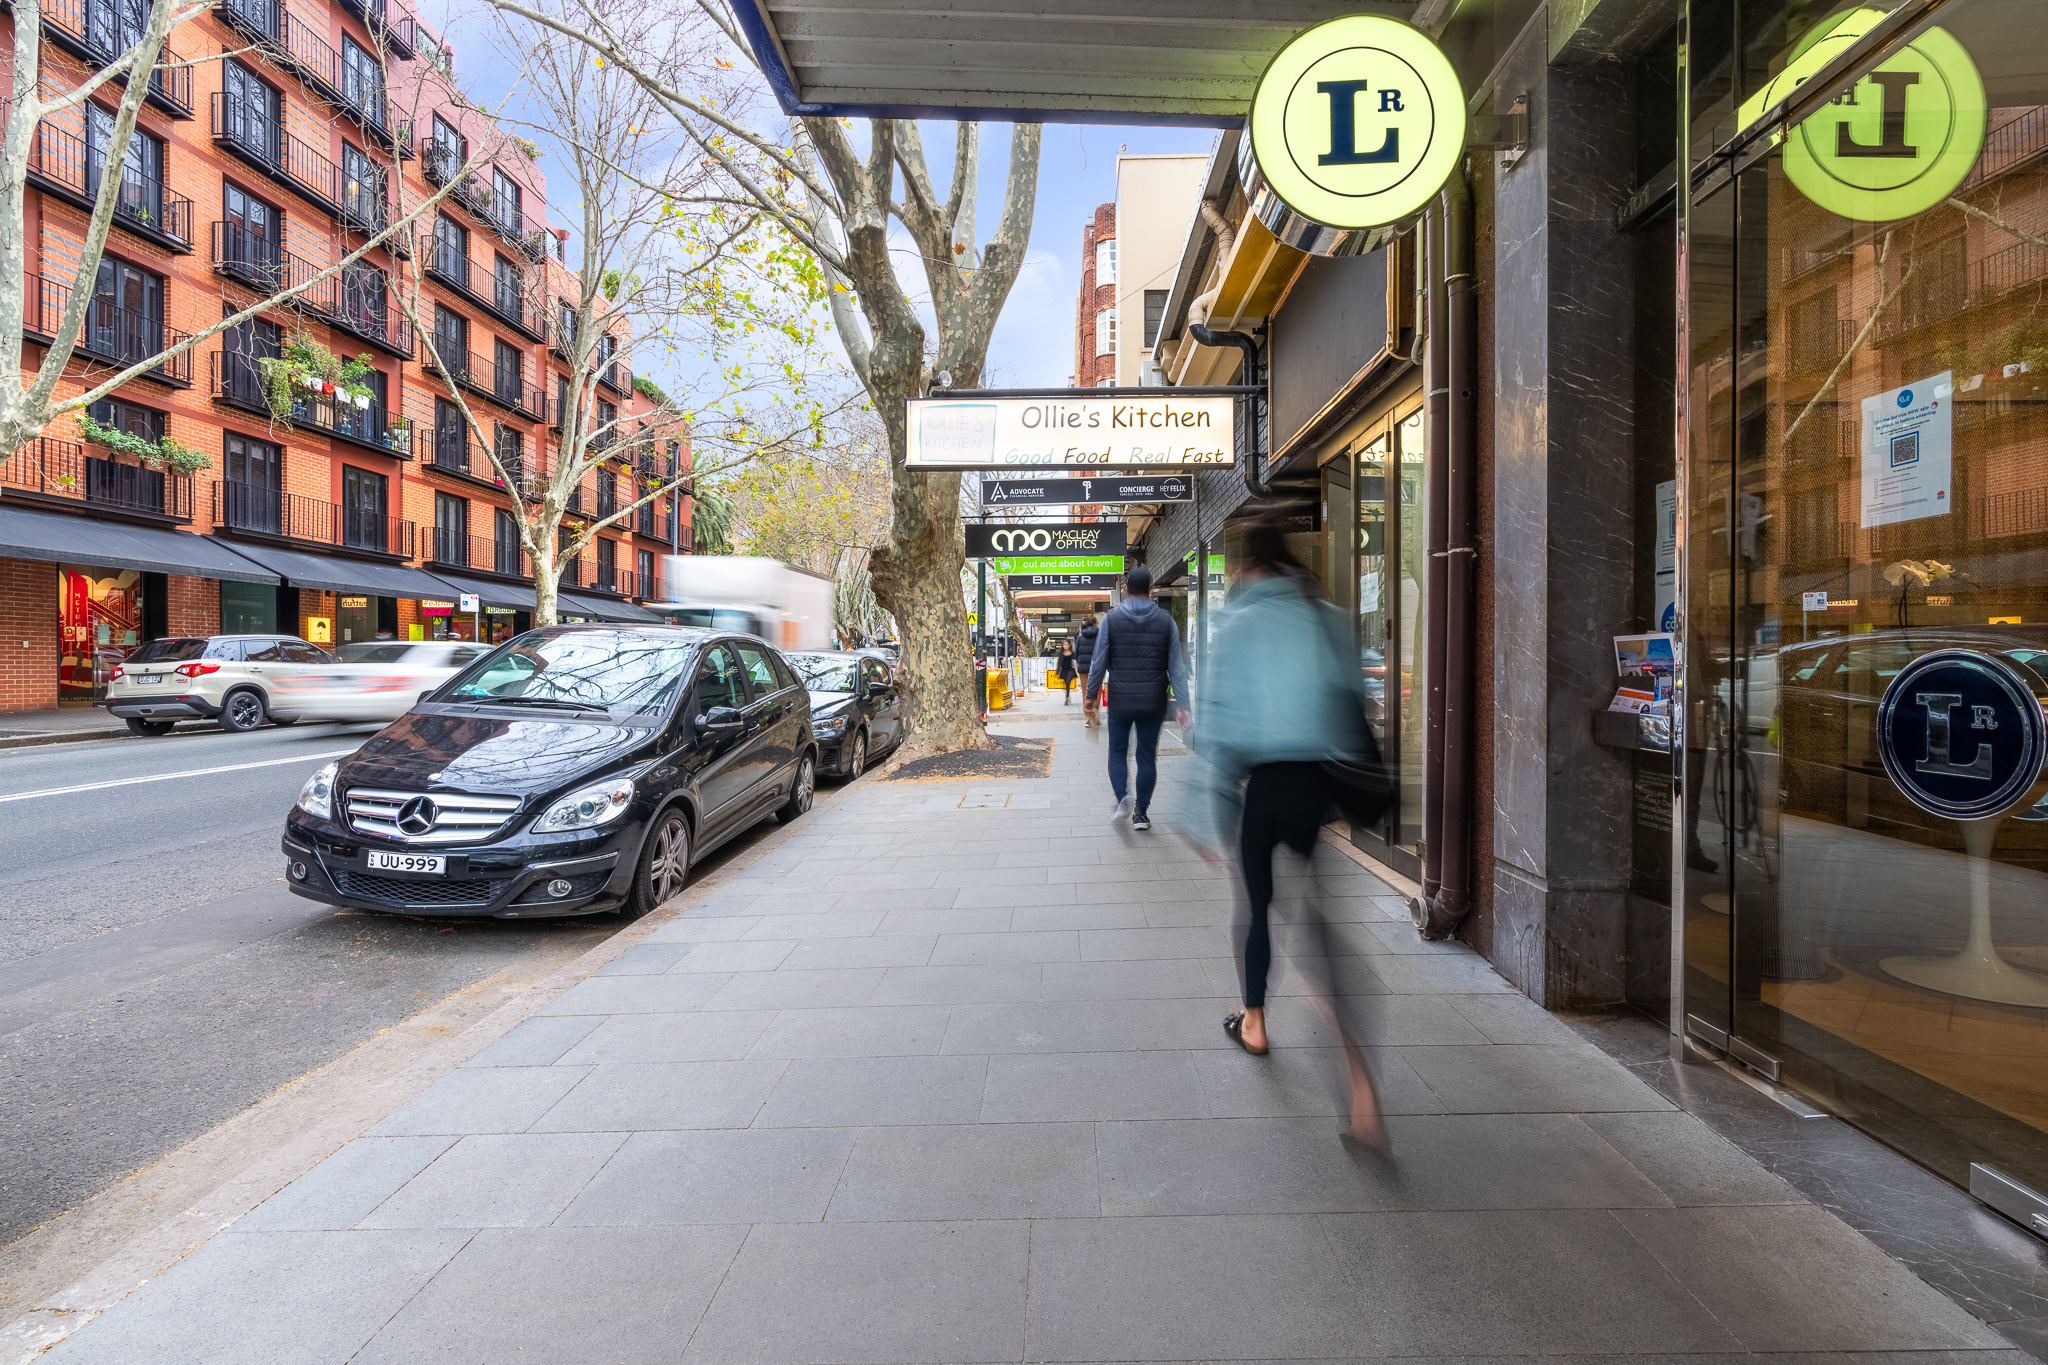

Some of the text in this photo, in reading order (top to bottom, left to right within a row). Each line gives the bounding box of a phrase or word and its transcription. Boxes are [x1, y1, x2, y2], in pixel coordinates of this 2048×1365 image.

[1021, 405, 1211, 429] Ollie's Kitchen
[1890, 412, 1907, 420] Service
[1900, 416, 1915, 424] before
[1915, 410, 1937, 419] entering
[927, 413, 984, 432] OLLIE'S
[924, 436, 982, 450] KITCHEN
[1005, 447, 1225, 464] Good Food Real Fast
[1119, 485, 1154, 493] CONCIERGE
[1170, 484, 1186, 492] FELIX
[1052, 529, 1101, 540] MACLEAY
[1055, 539, 1097, 549] OPTICS
[1023, 560, 1038, 568] out
[1040, 560, 1057, 568] and
[1087, 559, 1113, 567] travel
[1032, 575, 1092, 584] BILLER
[74, 592, 82, 627] METRO
[425, 607, 439, 615] POP
